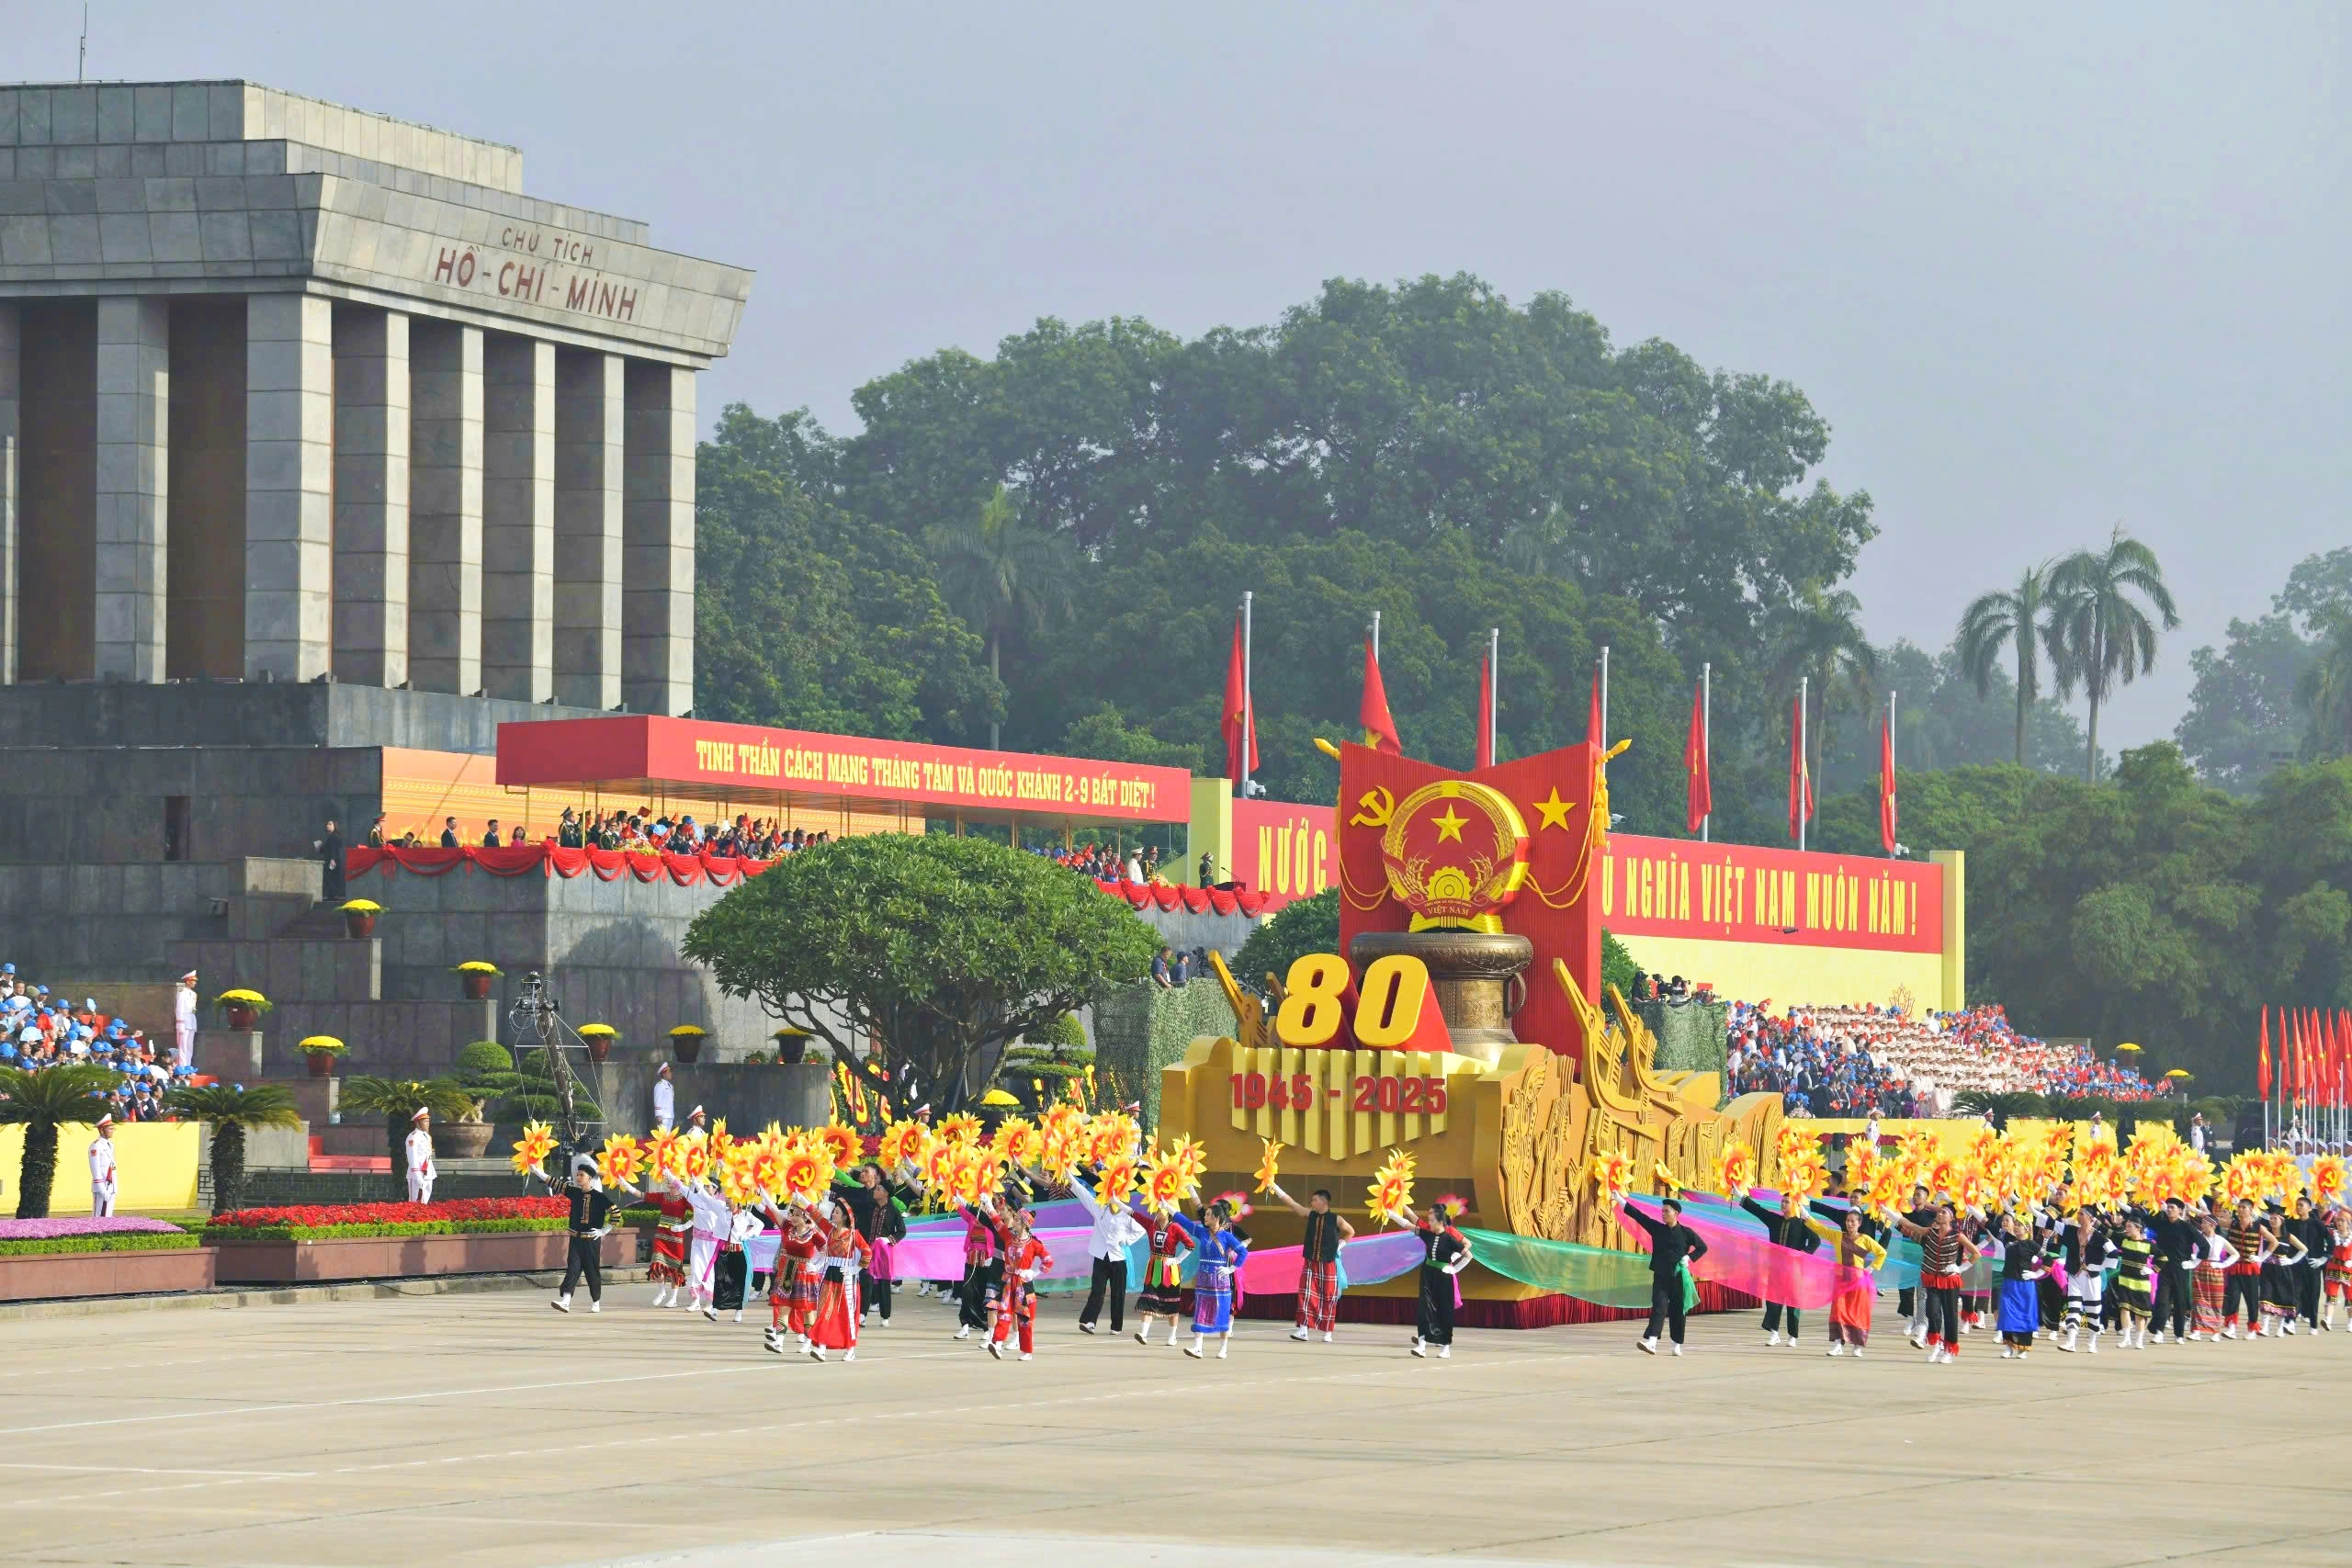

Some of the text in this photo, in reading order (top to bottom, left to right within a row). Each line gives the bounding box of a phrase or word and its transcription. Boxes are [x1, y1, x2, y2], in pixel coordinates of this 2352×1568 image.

[695, 740, 734, 773] TINH
[739, 737, 780, 777] THẦN
[785, 743, 823, 780] CÁCH
[828, 752, 867, 788] MẠNG
[872, 754, 919, 789] THÁNG
[923, 757, 953, 792] TÁM
[957, 760, 975, 795] VÀ
[978, 761, 1013, 797] QUỐC
[1017, 766, 1061, 801] KHÁNH
[1092, 771, 1117, 806] BẤT
[1258, 817, 1327, 897] NƯỚC
[1626, 852, 1690, 920] NGHĨA
[1702, 855, 1746, 934] VIỆT
[1755, 868, 1795, 927] NAM
[1806, 864, 1859, 931] MUÔN
[1449, 906, 1469, 916] NAM
[1276, 953, 1428, 1046] 80
[1228, 1073, 1313, 1111] 1945
[1353, 1076, 1446, 1114] 2025
